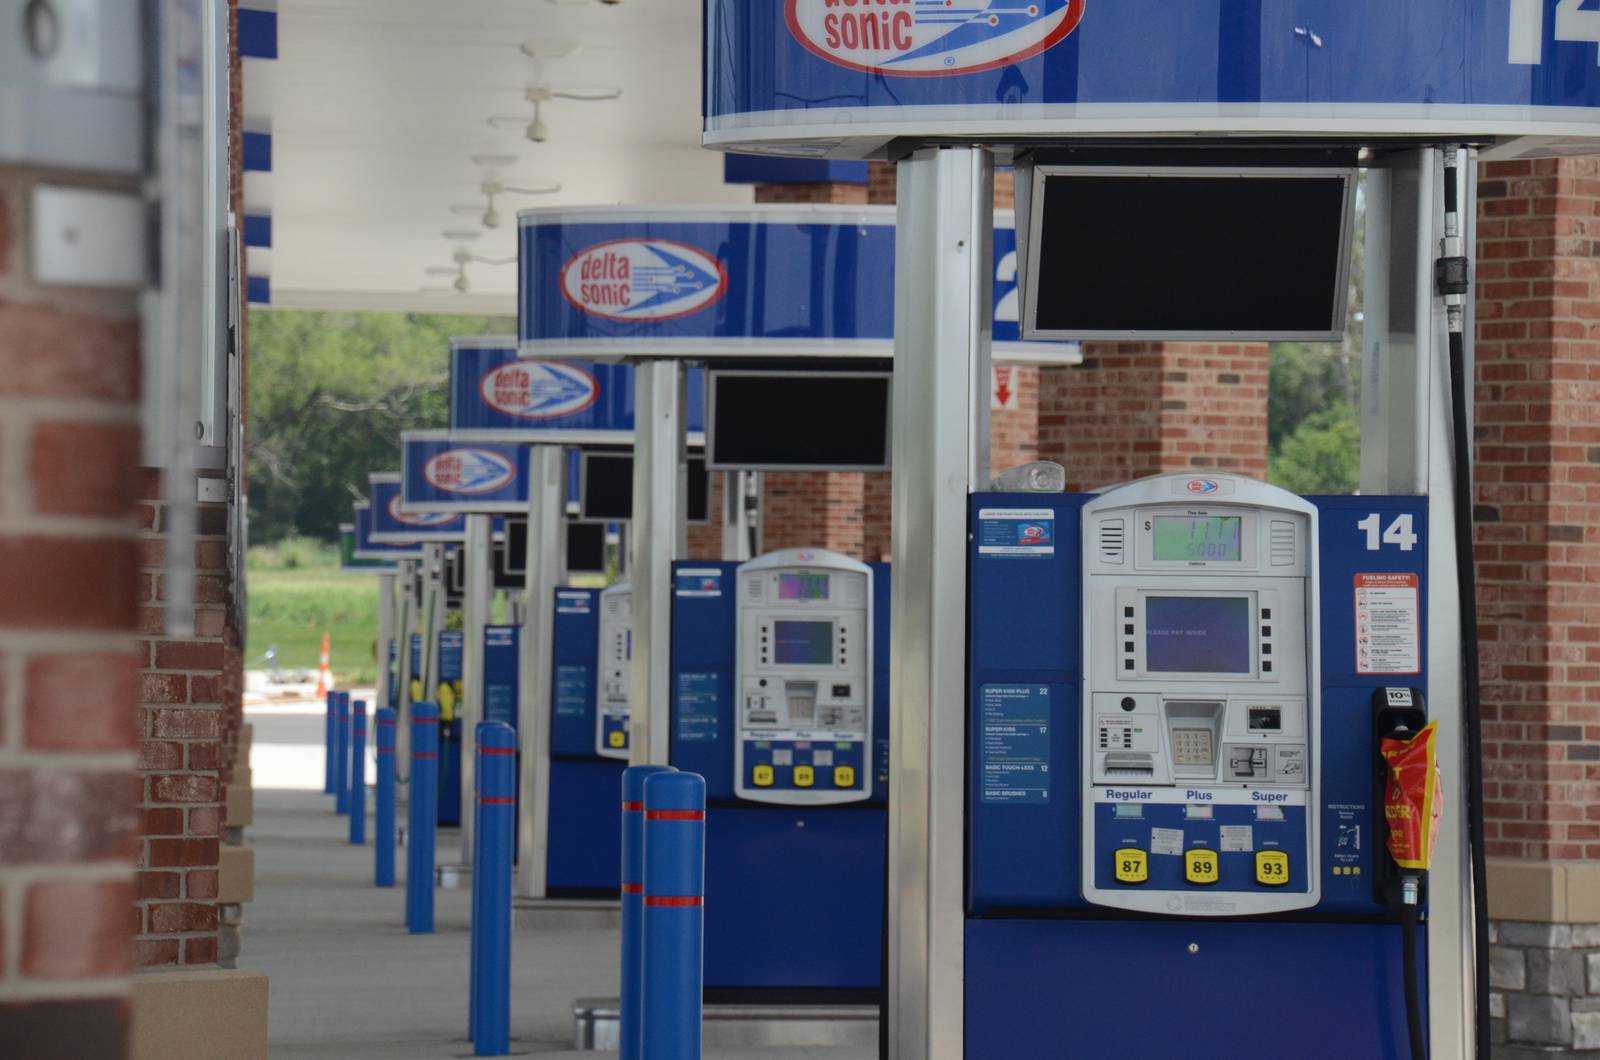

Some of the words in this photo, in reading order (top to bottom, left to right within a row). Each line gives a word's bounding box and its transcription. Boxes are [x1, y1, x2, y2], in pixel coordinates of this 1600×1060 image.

[580, 252, 630, 280] delta
[580, 283, 631, 306] sonic
[493, 370, 530, 389] delta
[1144, 520, 1152, 531] $
[1358, 513, 1417, 551] 14
[1040, 726, 1047, 734] 17
[1041, 764, 1048, 772] 12
[1106, 789, 1153, 802] Regular
[1186, 790, 1213, 800] Plus
[1252, 791, 1288, 803] Super
[1122, 860, 1141, 873] 87
[1193, 861, 1212, 874] 89
[1263, 862, 1283, 876] 93
